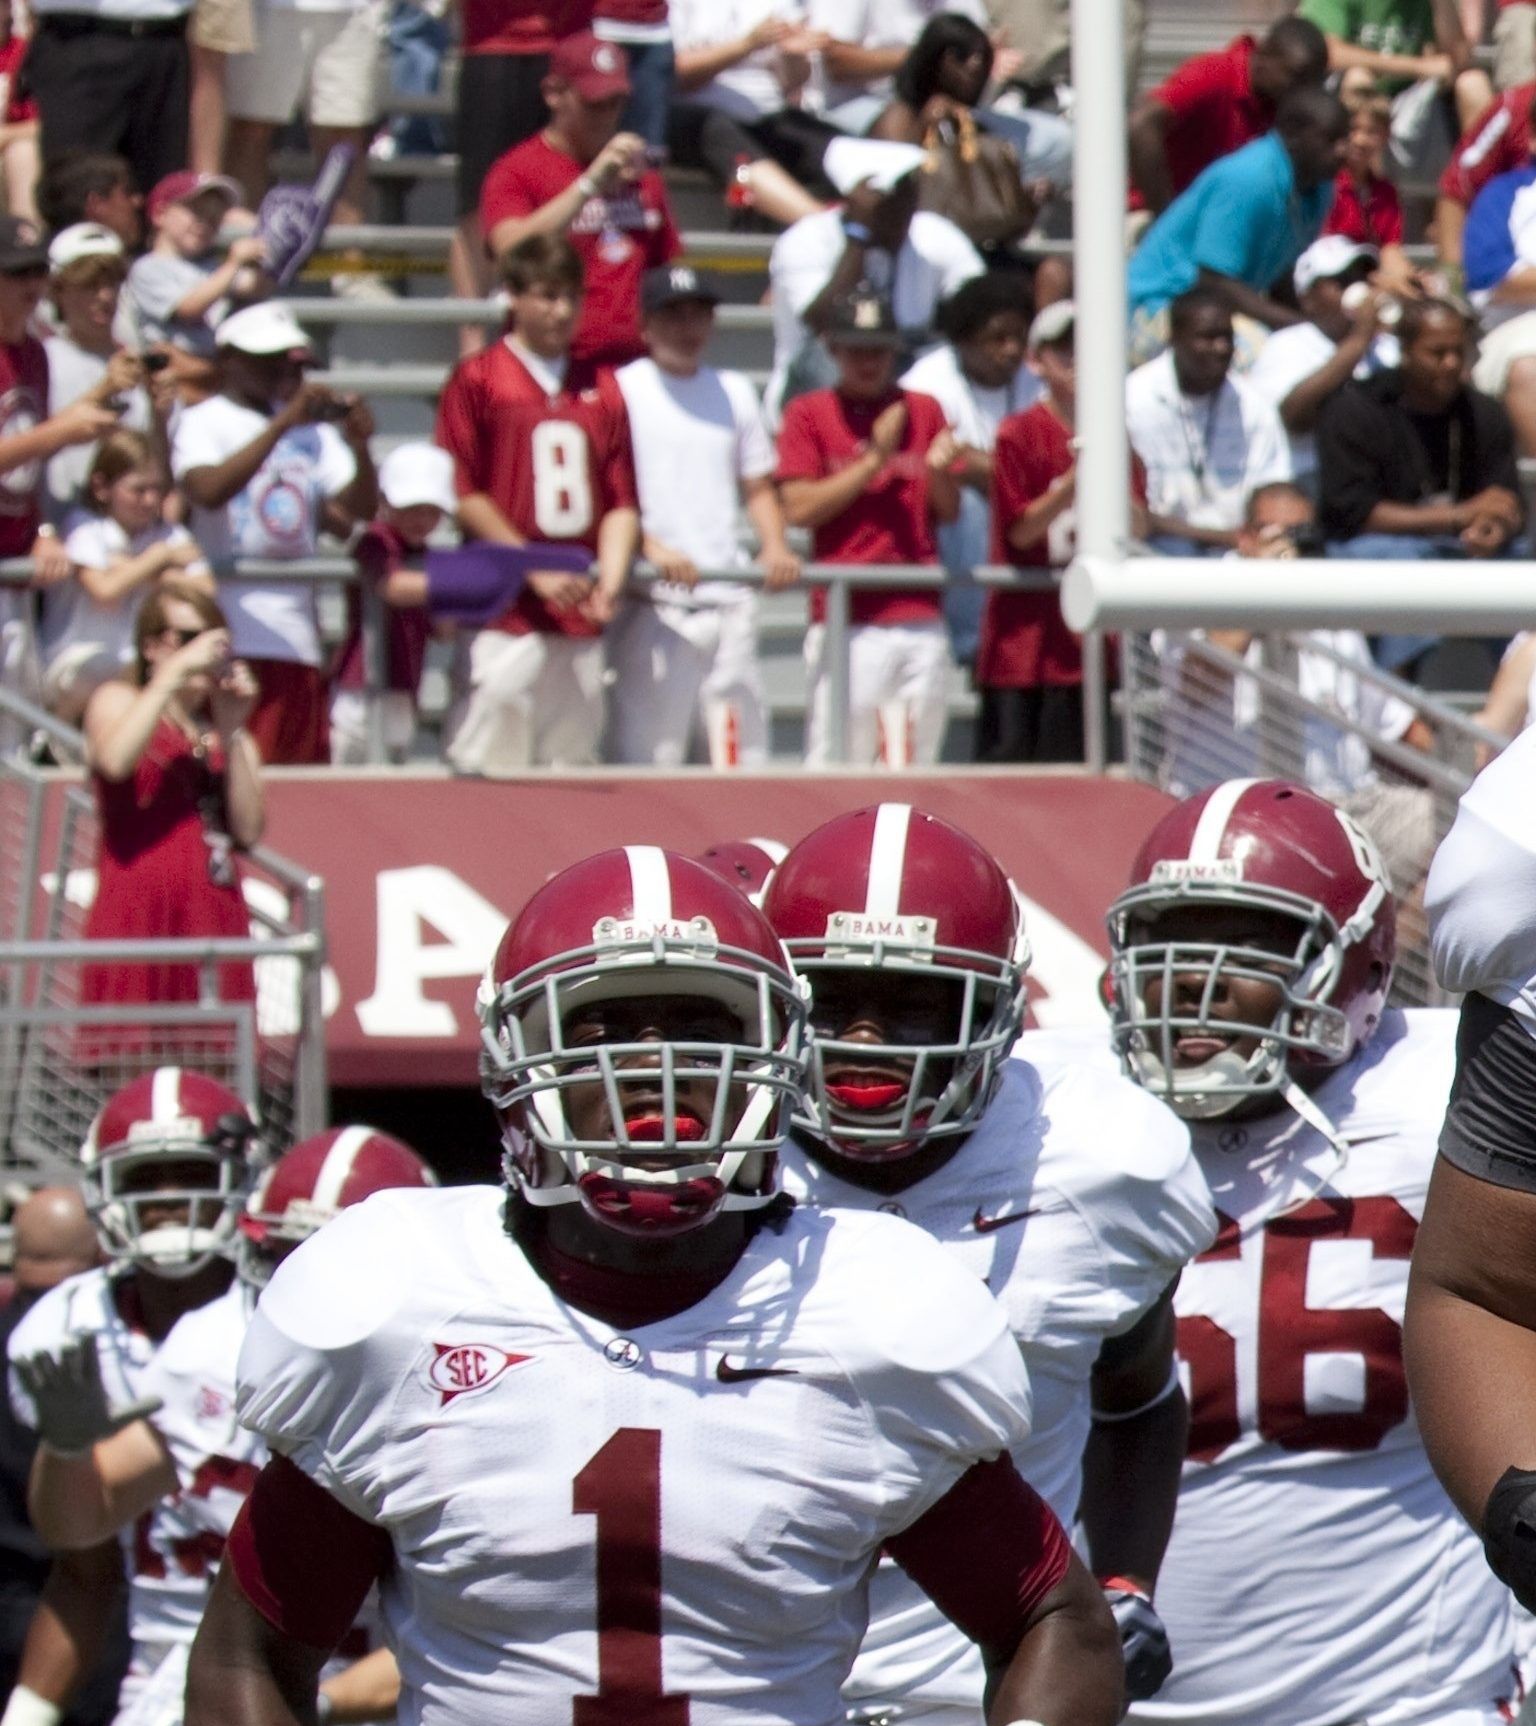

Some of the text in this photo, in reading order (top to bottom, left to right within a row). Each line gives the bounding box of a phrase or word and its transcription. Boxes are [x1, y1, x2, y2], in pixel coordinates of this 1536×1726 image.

[531, 419, 593, 538] 8
[852, 920, 905, 937] BAMA
[446, 1349, 488, 1388] SEC
